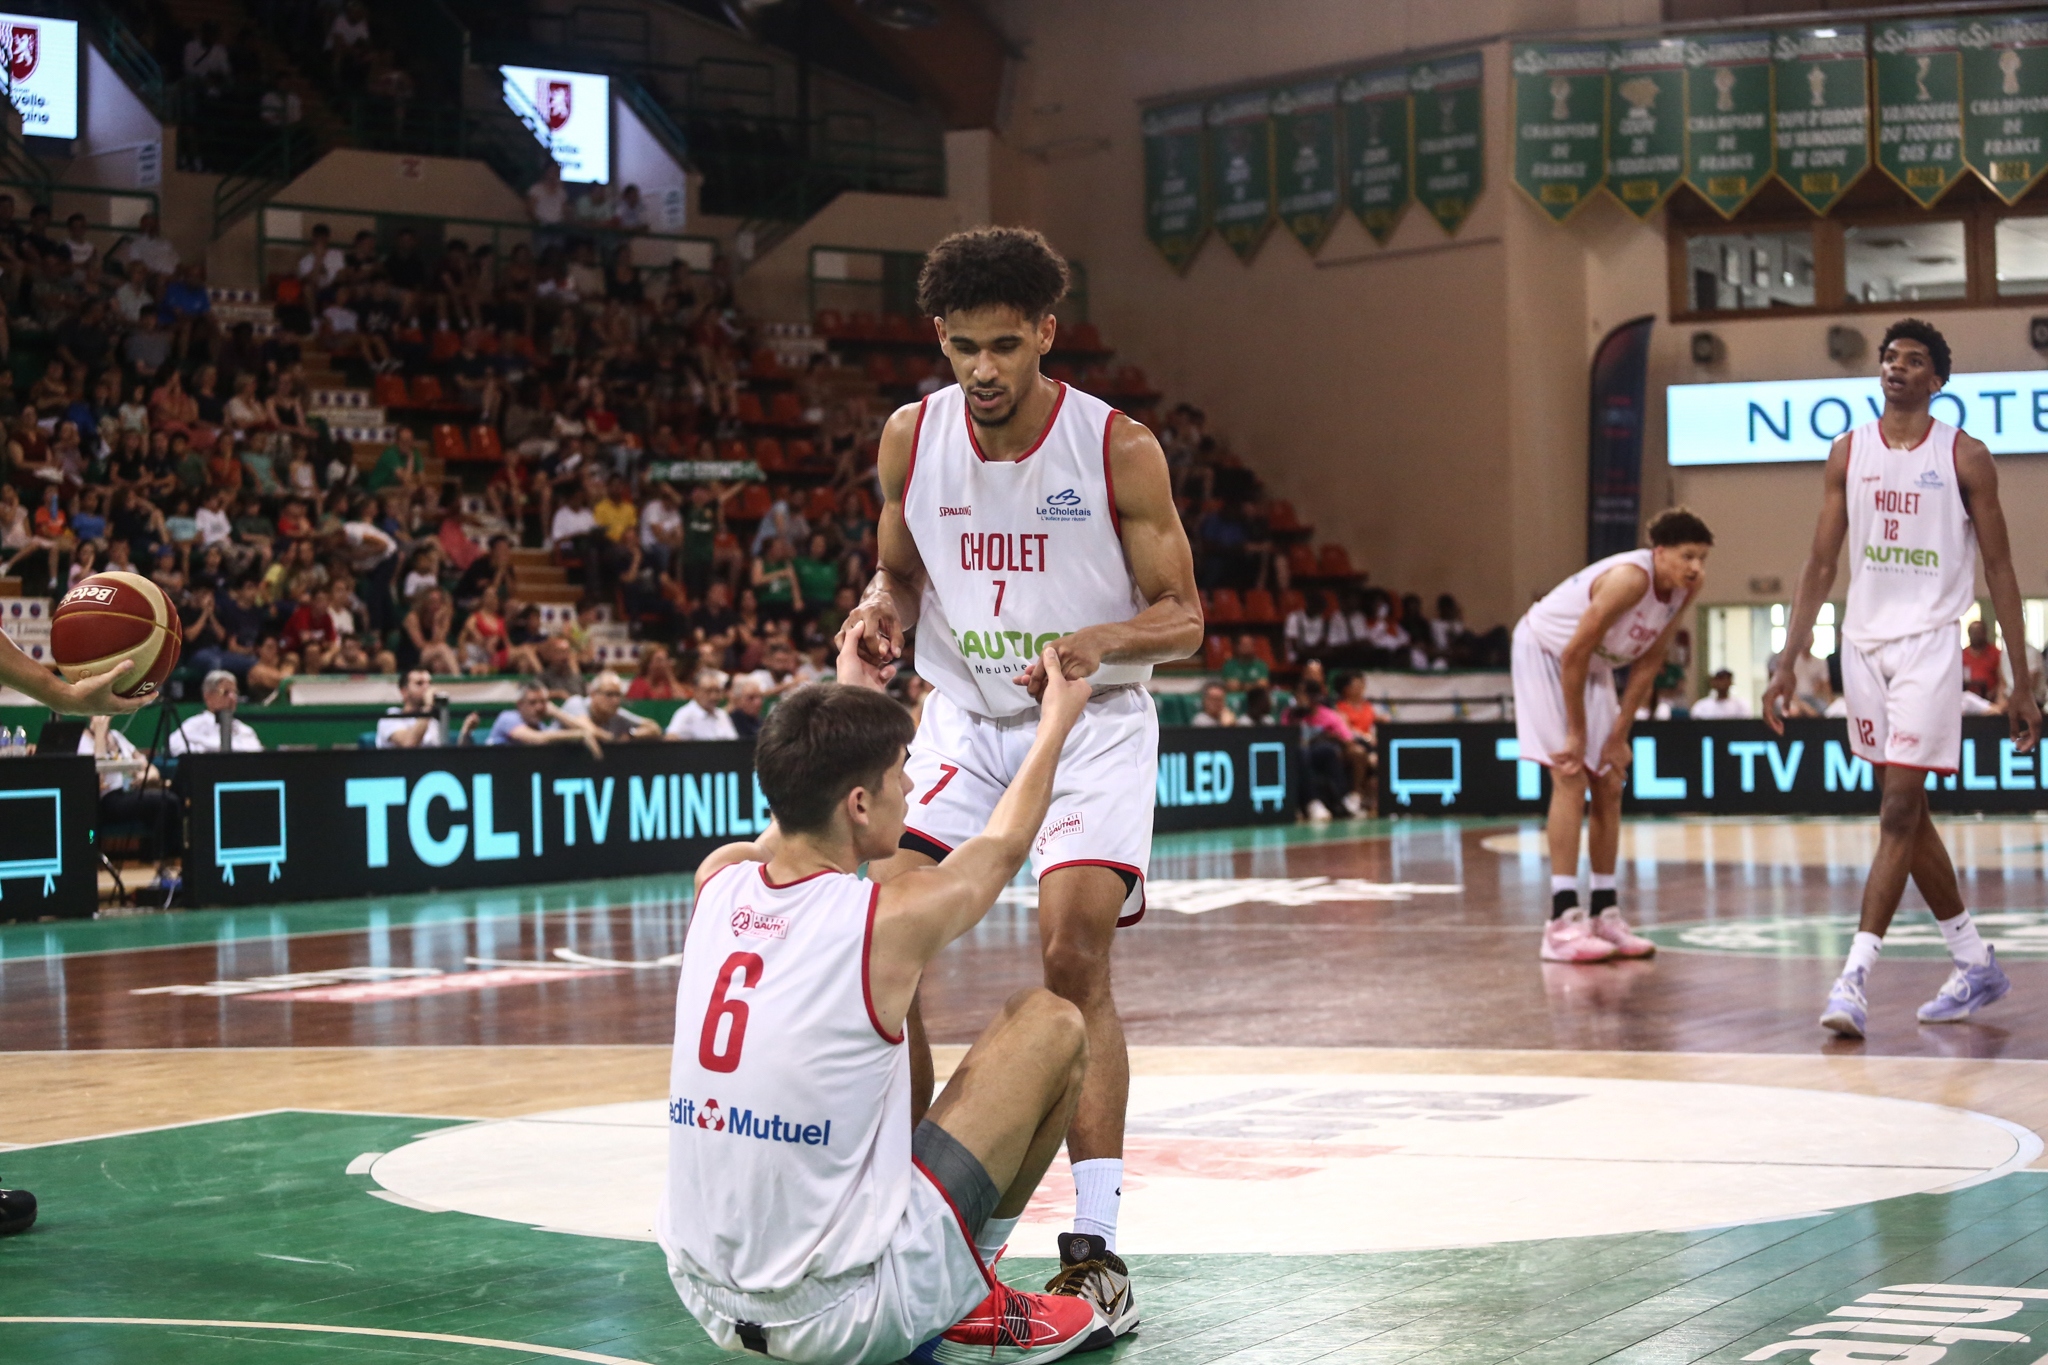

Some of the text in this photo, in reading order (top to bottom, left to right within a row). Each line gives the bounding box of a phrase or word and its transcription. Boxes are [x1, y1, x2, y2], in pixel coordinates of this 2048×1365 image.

[939, 505, 972, 517] SPALDING
[1036, 507, 1091, 516] Le Choletais
[1875, 490, 1920, 514] HOLET
[1884, 519, 1899, 541] 12
[961, 533, 1049, 572] CHOLET
[1865, 545, 1938, 567] AUTIER
[992, 580, 1006, 616] 7
[975, 664, 1027, 674] Meuble
[1856, 717, 1876, 746] 12
[919, 763, 959, 805] 7
[1155, 751, 1234, 807] NILED
[1496, 736, 1687, 800] TL
[1727, 740, 1804, 792] TV
[345, 770, 519, 867] TCL
[553, 772, 770, 846] TV MINILE
[1049, 818, 1081, 837] GAUTIER
[754, 921, 781, 931] GAUTI
[698, 951, 764, 1074] 6
[729, 1107, 831, 1146] Mutuel
